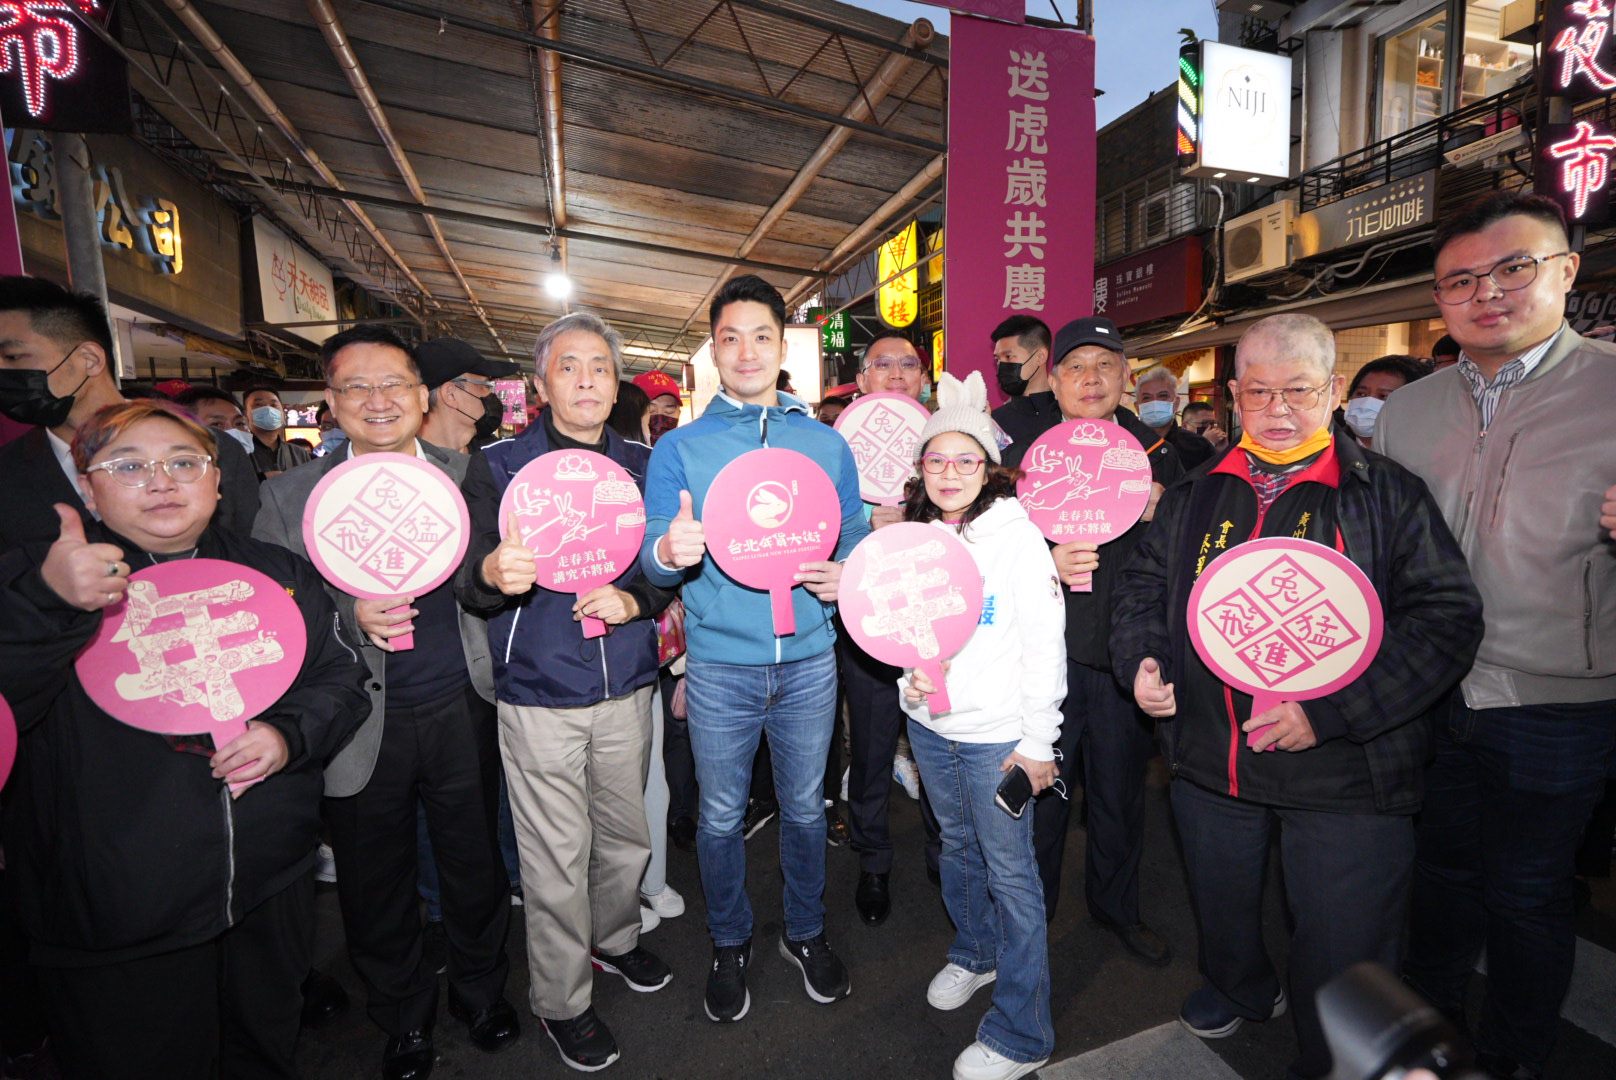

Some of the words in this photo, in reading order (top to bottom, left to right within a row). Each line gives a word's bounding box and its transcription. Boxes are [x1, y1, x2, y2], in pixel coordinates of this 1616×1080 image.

[1228, 87, 1266, 117] NIJI
[1549, 0, 1616, 218] 夜市
[1003, 50, 1050, 312] 送虎歲共慶
[873, 411, 893, 433] 兔
[874, 462, 897, 483] 進
[375, 481, 402, 511] 兔
[1052, 522, 1112, 535] 講究不將就
[1057, 509, 1105, 521] 走春美食
[336, 517, 371, 551] 飛
[403, 517, 438, 543] 猛
[728, 530, 821, 555] 台北年貨大街
[1215, 520, 1234, 549] 會長
[374, 549, 410, 576] 進
[553, 561, 616, 584] 講究不將就
[558, 549, 606, 568] 走春美食
[1265, 568, 1300, 603] 兔
[1219, 600, 1257, 637] 飛
[1298, 616, 1338, 648] 猛
[1252, 641, 1289, 676] 進
